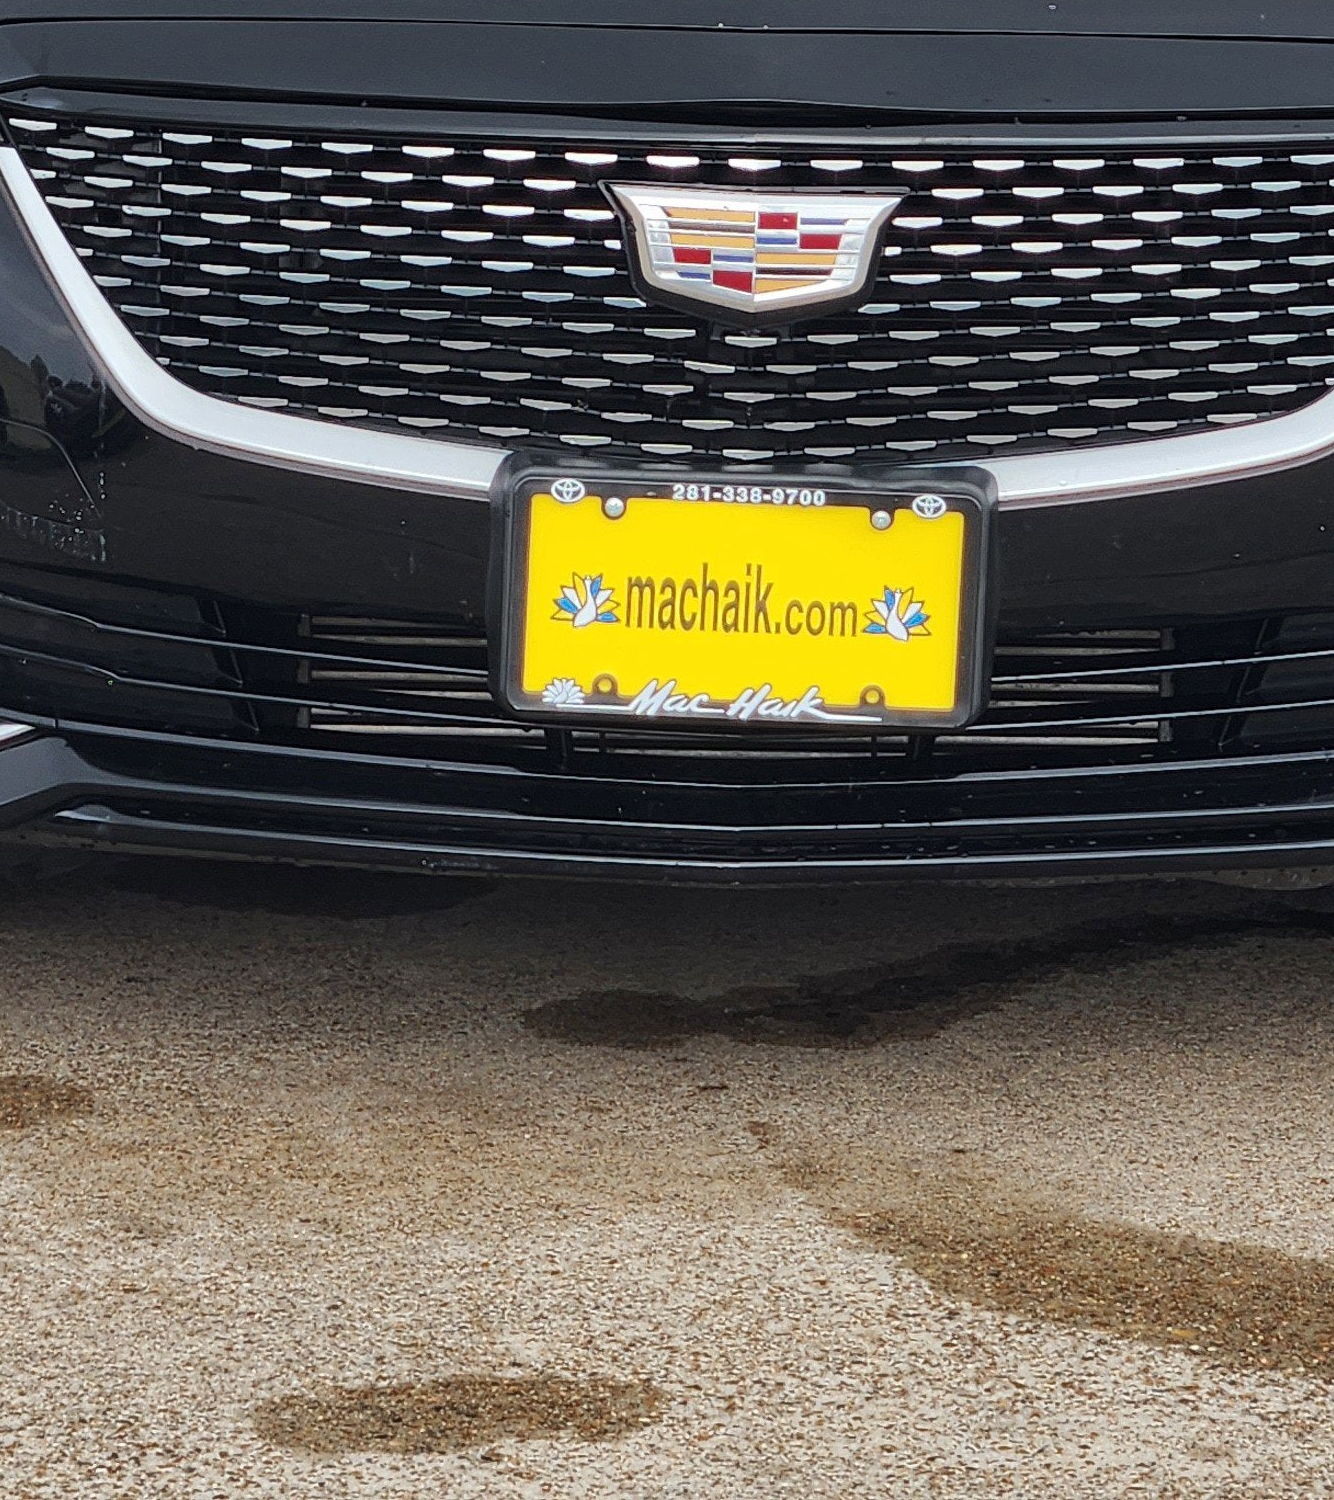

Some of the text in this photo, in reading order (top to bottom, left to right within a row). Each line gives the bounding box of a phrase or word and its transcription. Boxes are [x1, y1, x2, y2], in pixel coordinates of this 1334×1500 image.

[672, 483, 827, 507] 281-338-9700
[624, 562, 858, 638] machaik.com
[631, 679, 827, 720] Mac Haik
